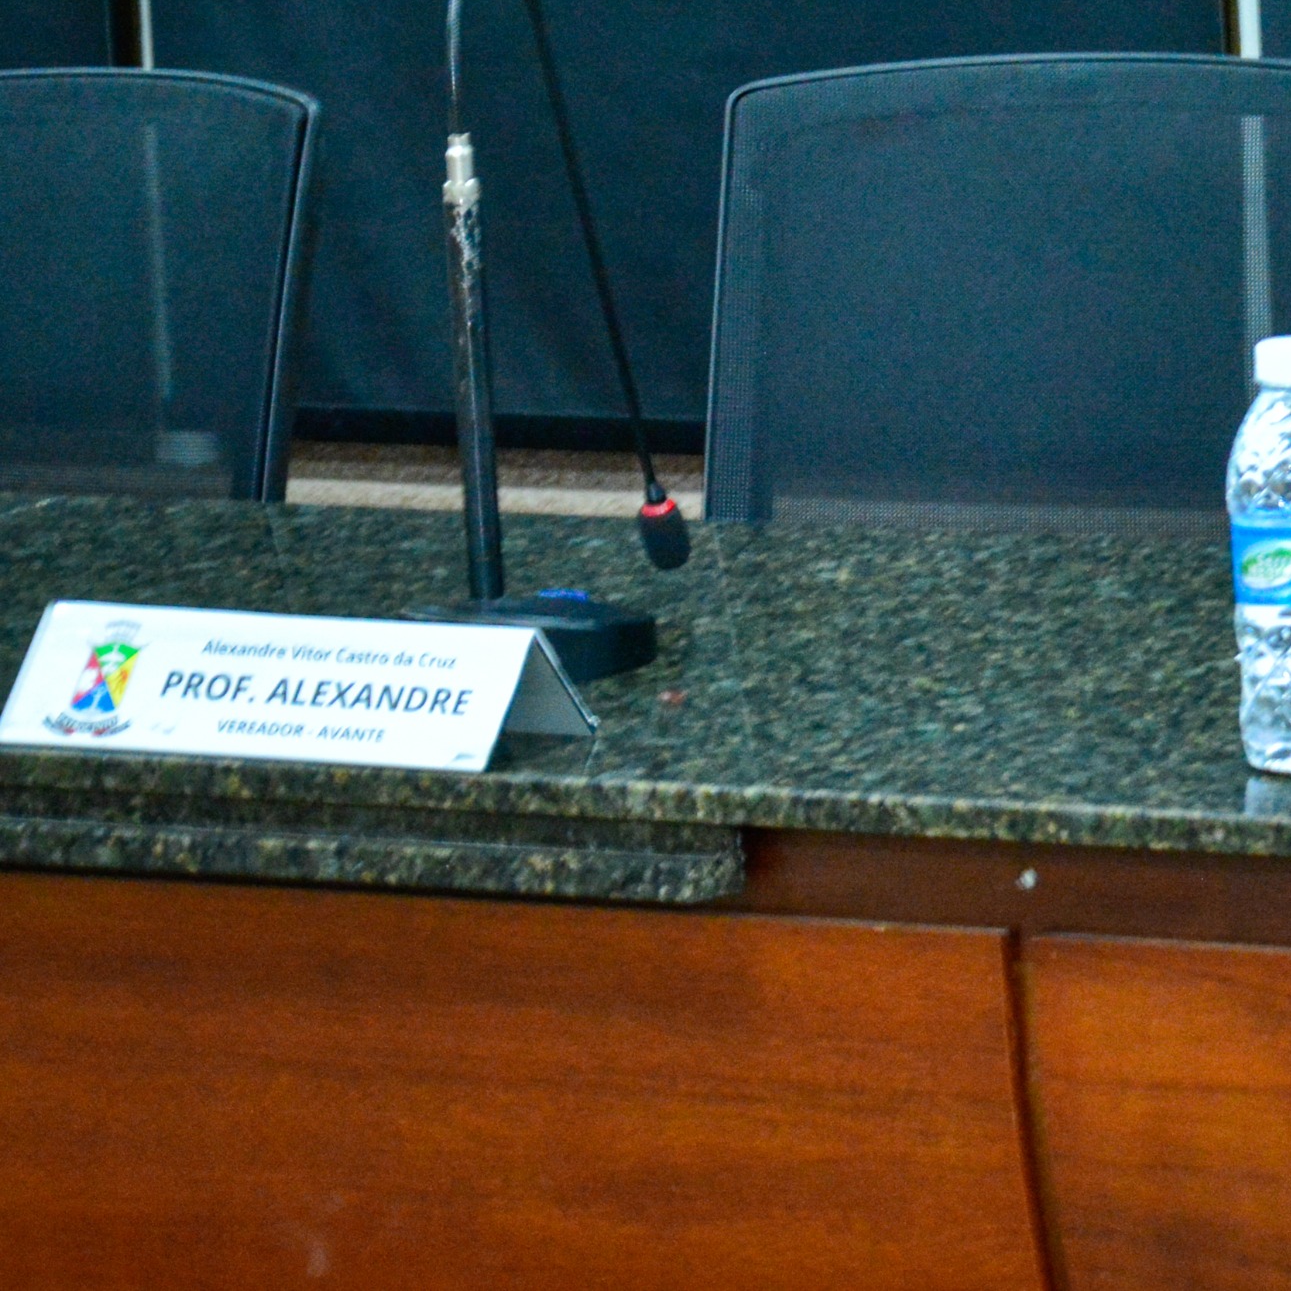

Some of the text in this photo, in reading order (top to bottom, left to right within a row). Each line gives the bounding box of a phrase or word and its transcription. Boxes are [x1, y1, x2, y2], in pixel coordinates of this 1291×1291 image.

[201, 639, 457, 670] Alexandre Vitor Castro da Cruz
[160, 670, 474, 716] PROF. ALEXANDRE
[217, 719, 304, 738] VEREADOR
[316, 725, 386, 744] AVANTE
